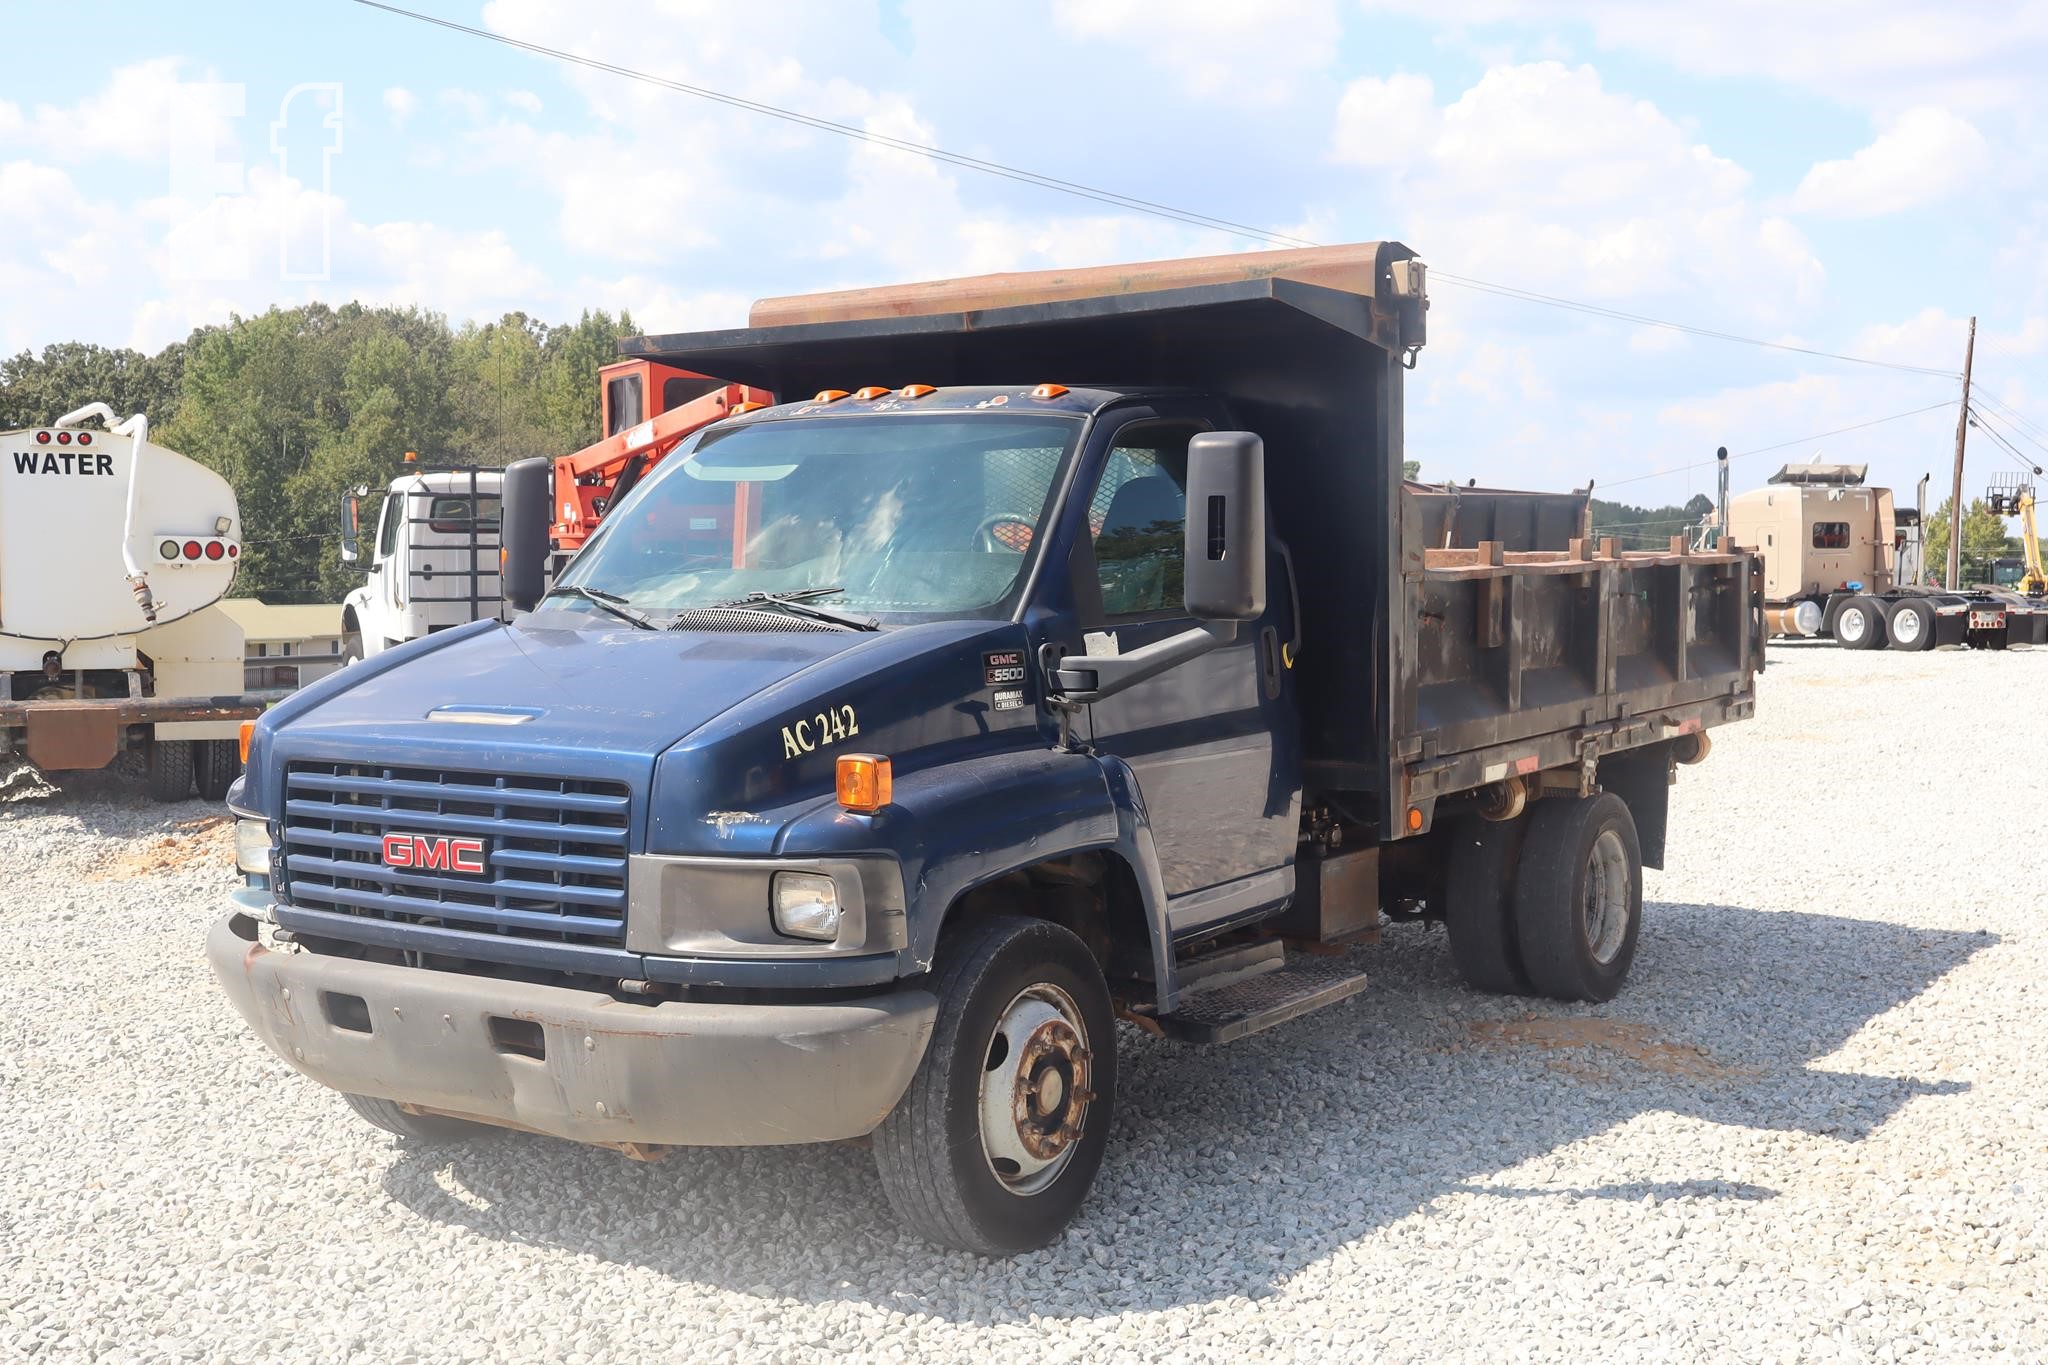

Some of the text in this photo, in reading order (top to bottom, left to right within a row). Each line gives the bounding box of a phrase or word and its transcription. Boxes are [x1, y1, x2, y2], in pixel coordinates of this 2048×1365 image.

[14, 452, 114, 476] WATER
[990, 653, 1018, 665] GMC
[987, 667, 1024, 683] C5500
[994, 690, 1023, 701] DURAMAX
[781, 704, 859, 760] AC 242
[383, 833, 484, 874] GMC
